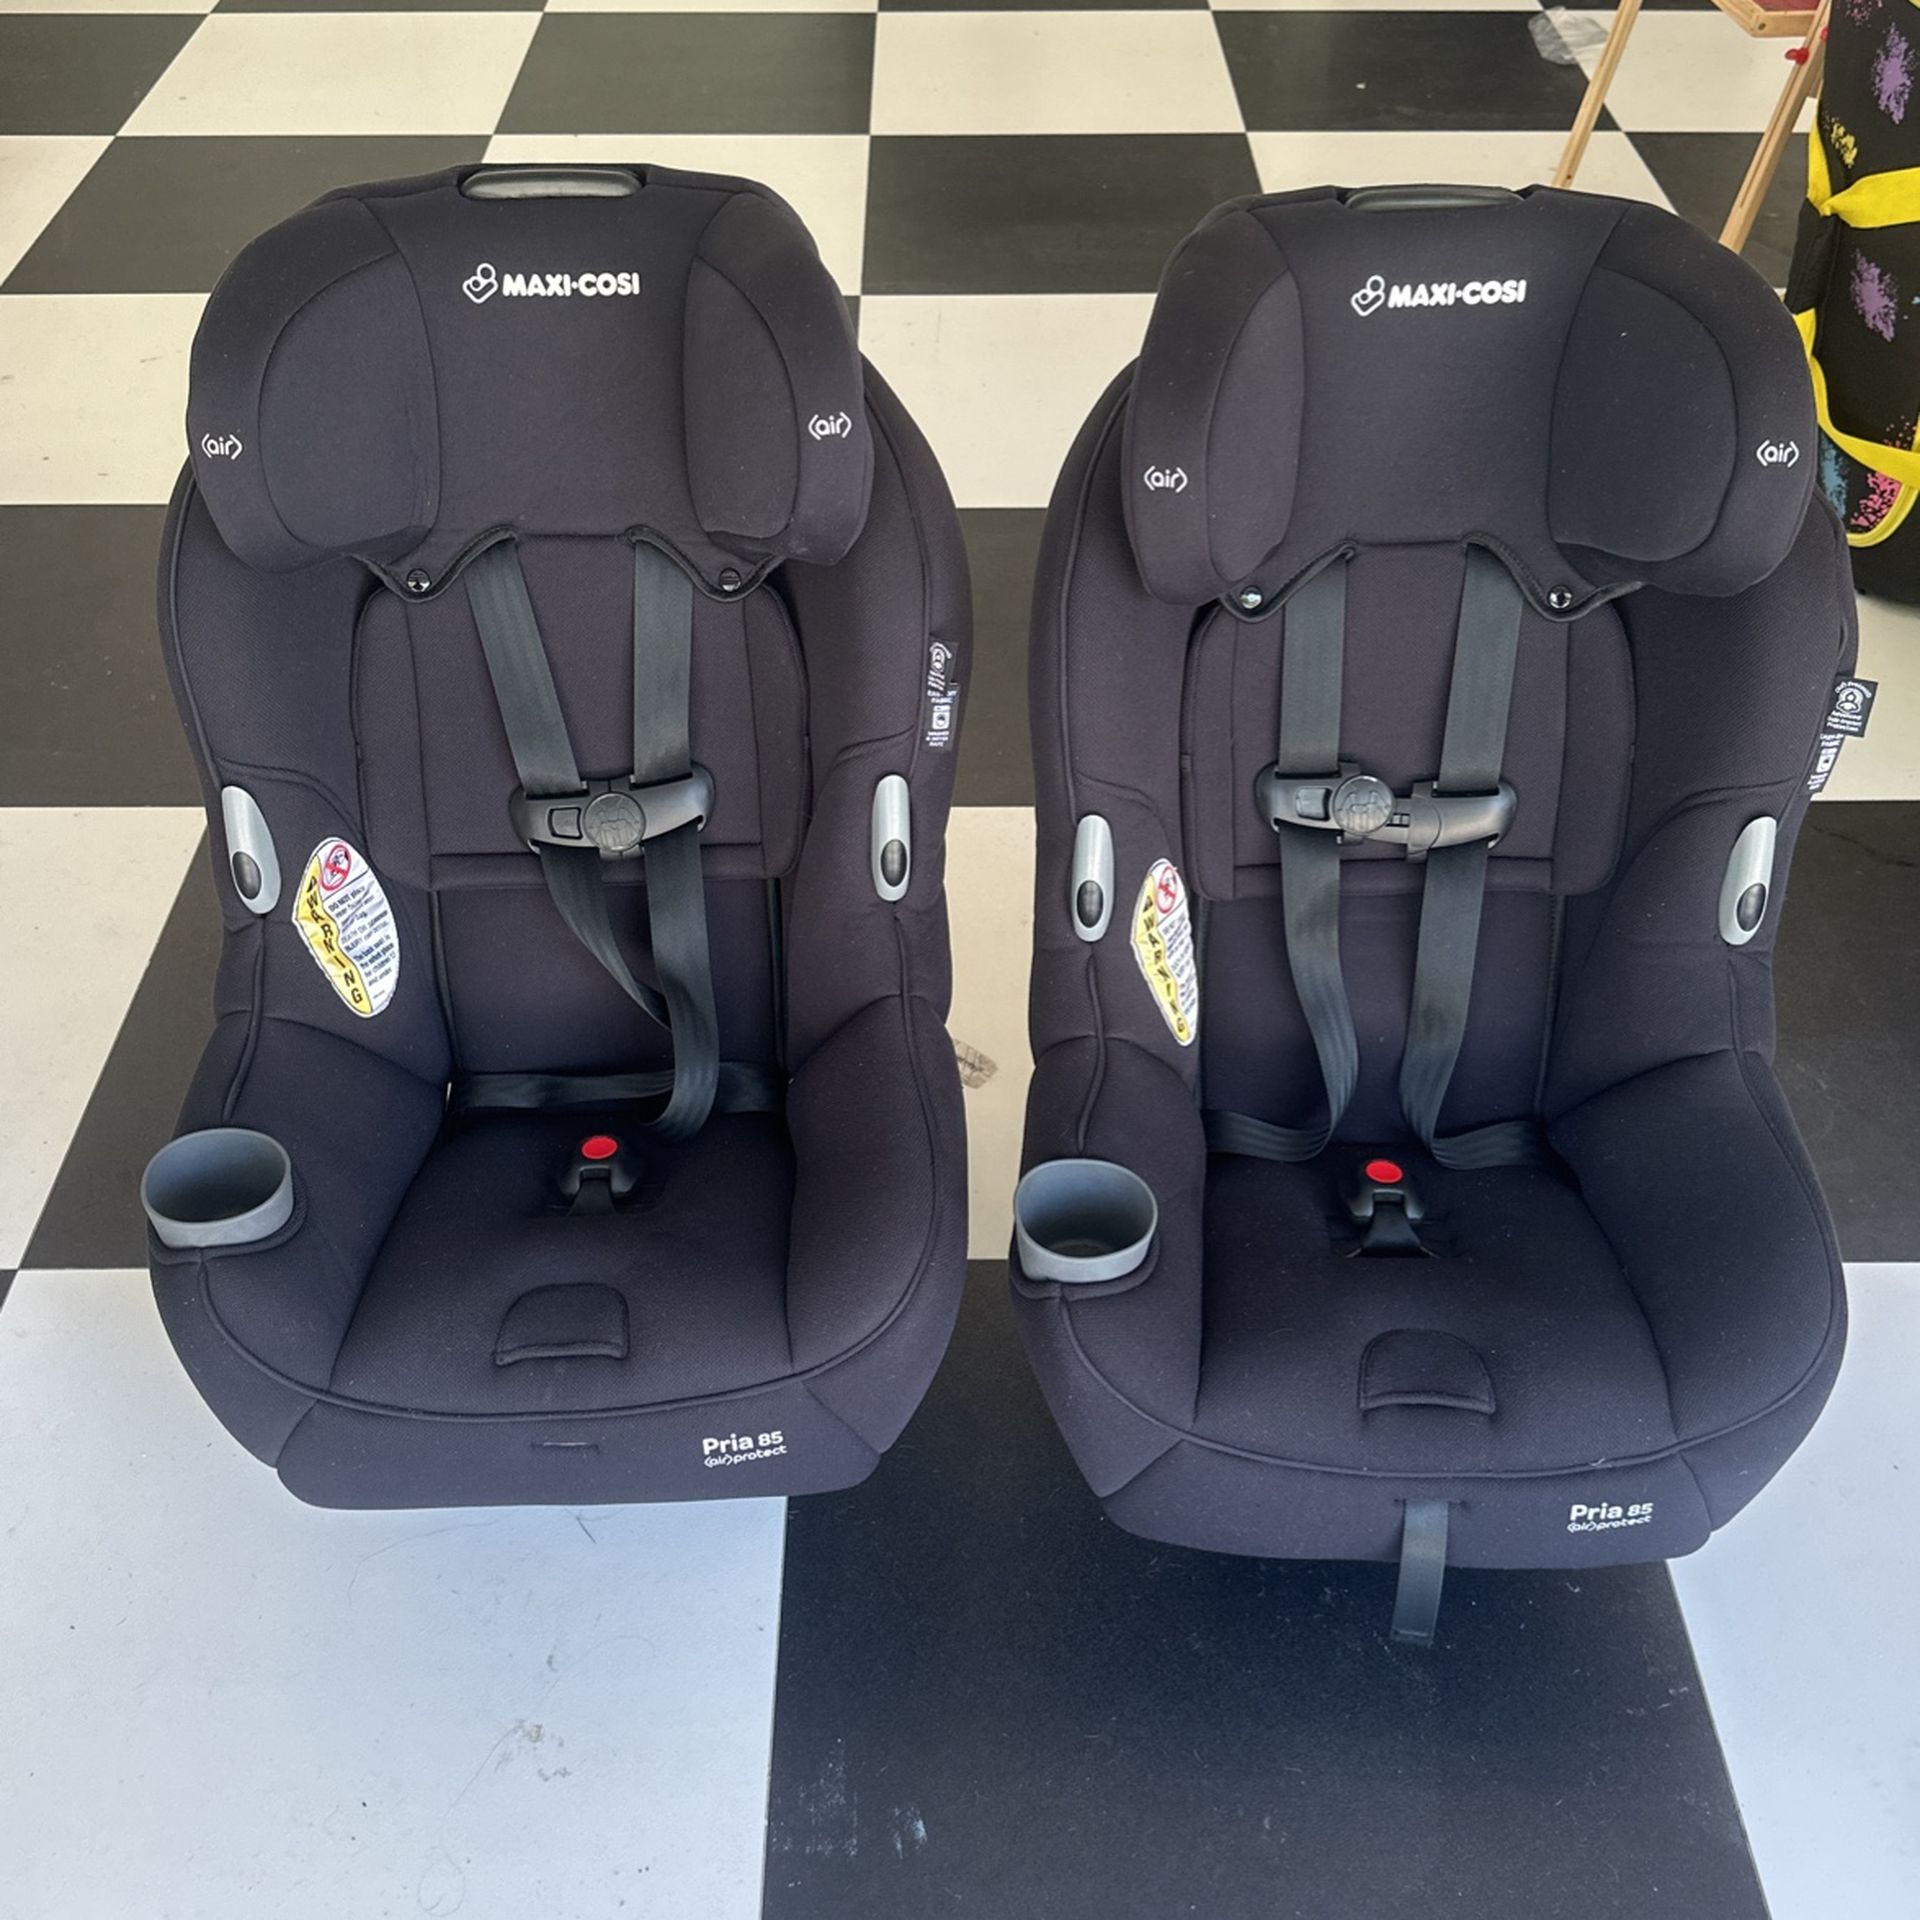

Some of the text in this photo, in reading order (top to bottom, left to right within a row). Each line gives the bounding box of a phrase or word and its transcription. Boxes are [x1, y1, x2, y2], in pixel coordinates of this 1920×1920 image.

[702, 1430, 784, 1456] Pria 85
[1570, 1502, 1654, 1521] Pria 85
